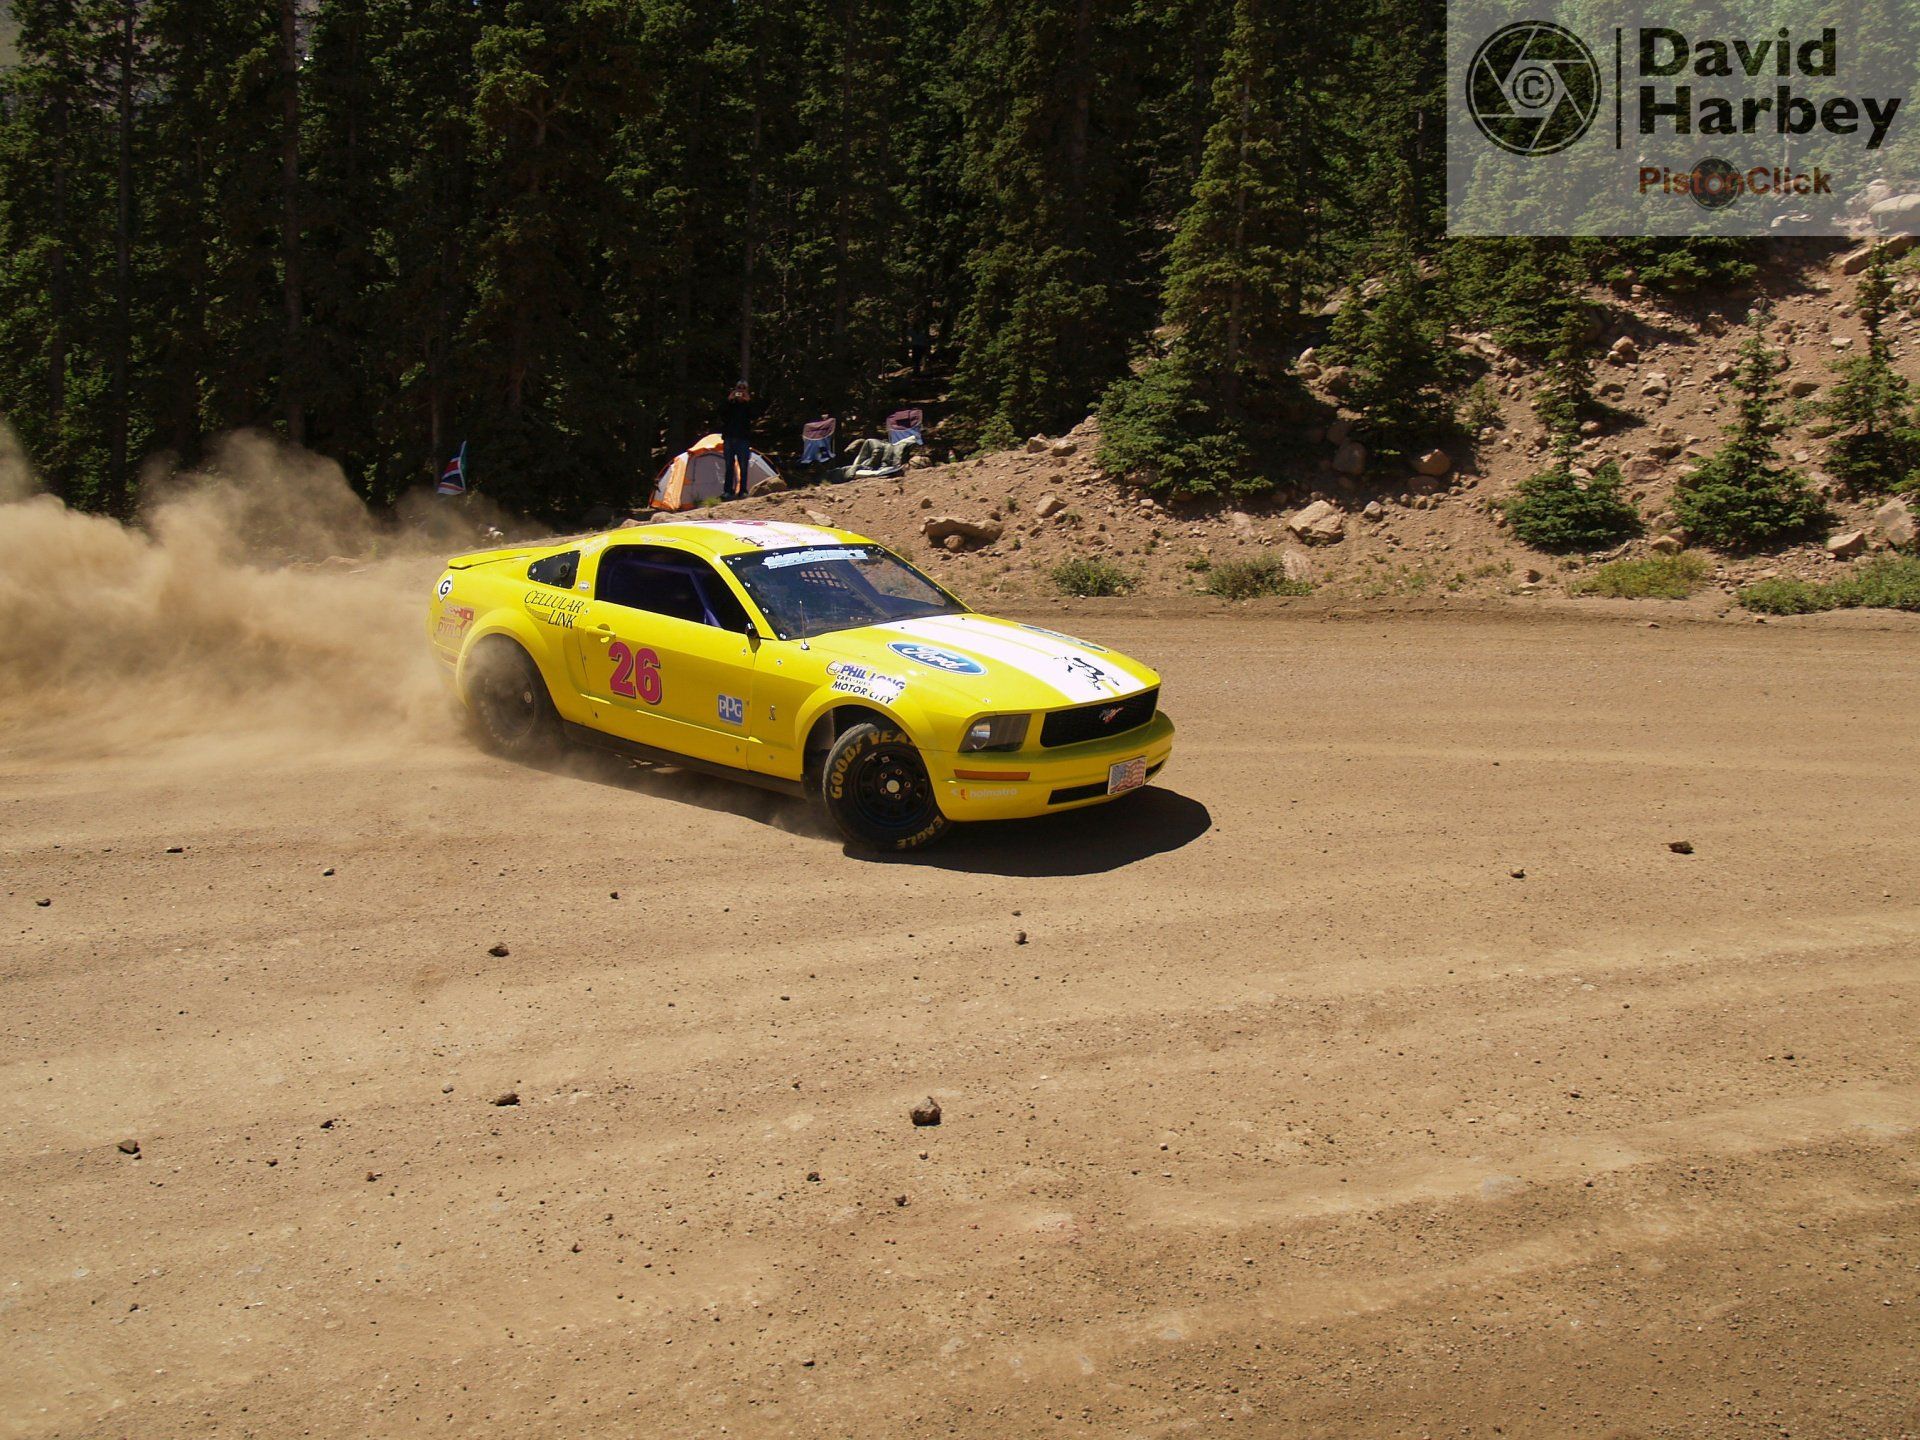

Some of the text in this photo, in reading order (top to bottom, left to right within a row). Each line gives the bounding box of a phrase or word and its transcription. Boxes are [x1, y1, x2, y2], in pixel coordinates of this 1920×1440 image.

[439, 579, 451, 595] G
[524, 590, 585, 614] CELLULAR
[547, 609, 577, 630] LINK
[608, 641, 663, 706] 26
[840, 665, 867, 680] PHIL
[832, 681, 868, 696] MOTOR
[718, 696, 742, 719] PPG
